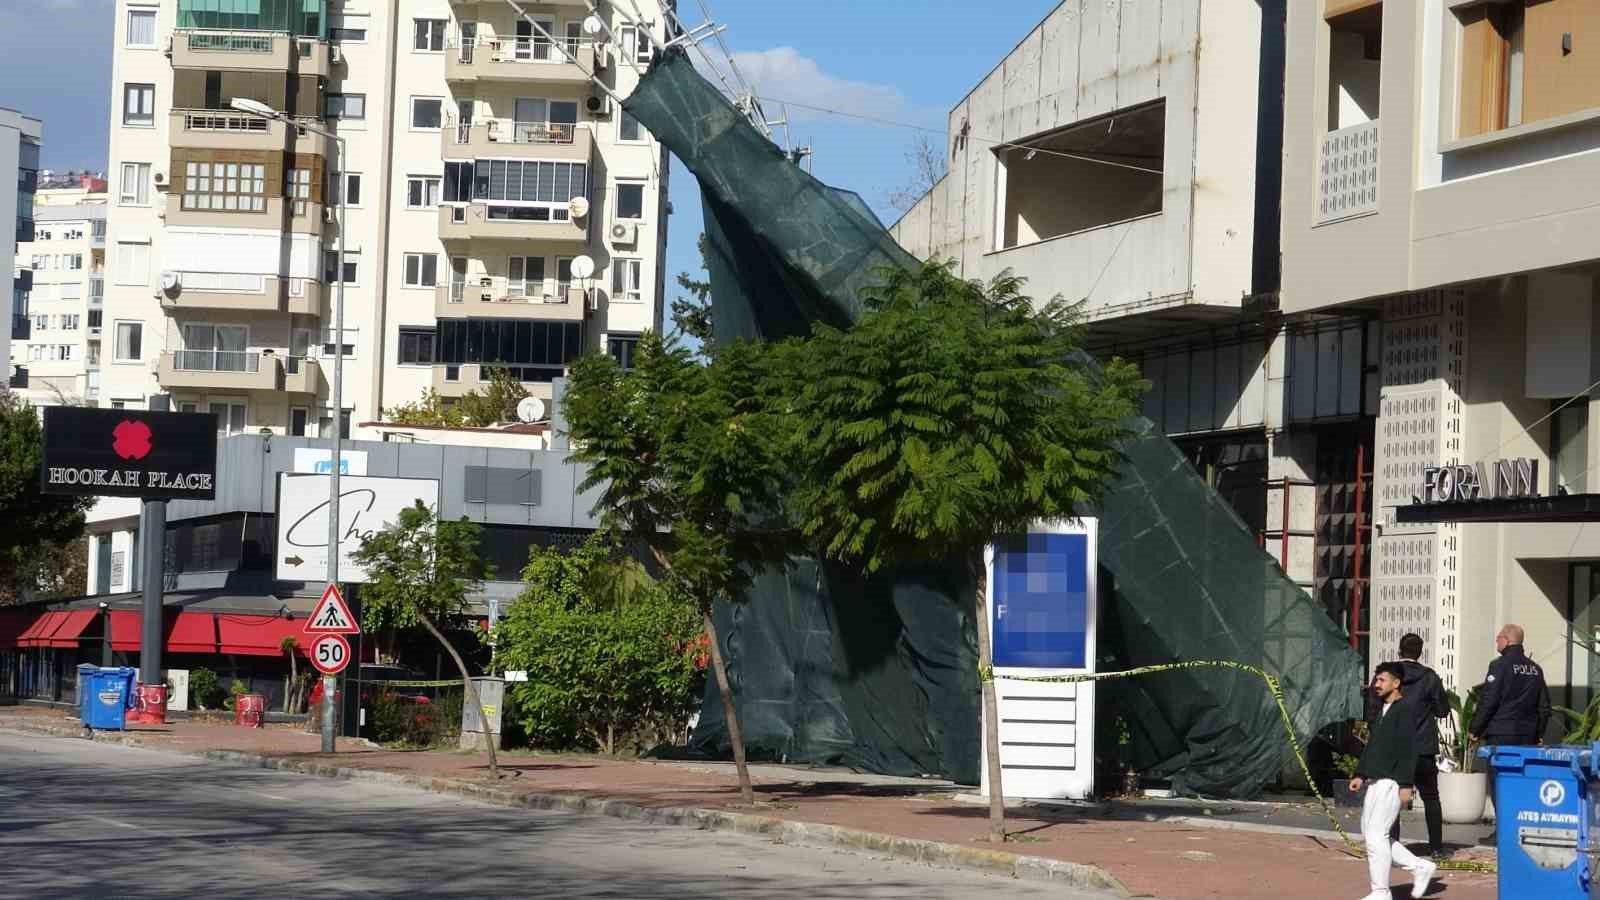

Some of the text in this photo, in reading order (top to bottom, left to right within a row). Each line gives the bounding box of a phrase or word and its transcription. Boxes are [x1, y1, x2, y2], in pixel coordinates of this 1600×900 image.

[48, 467, 212, 490] HOOKAH PLACE
[1424, 462, 1488, 502] FORA
[319, 643, 343, 662] 50
